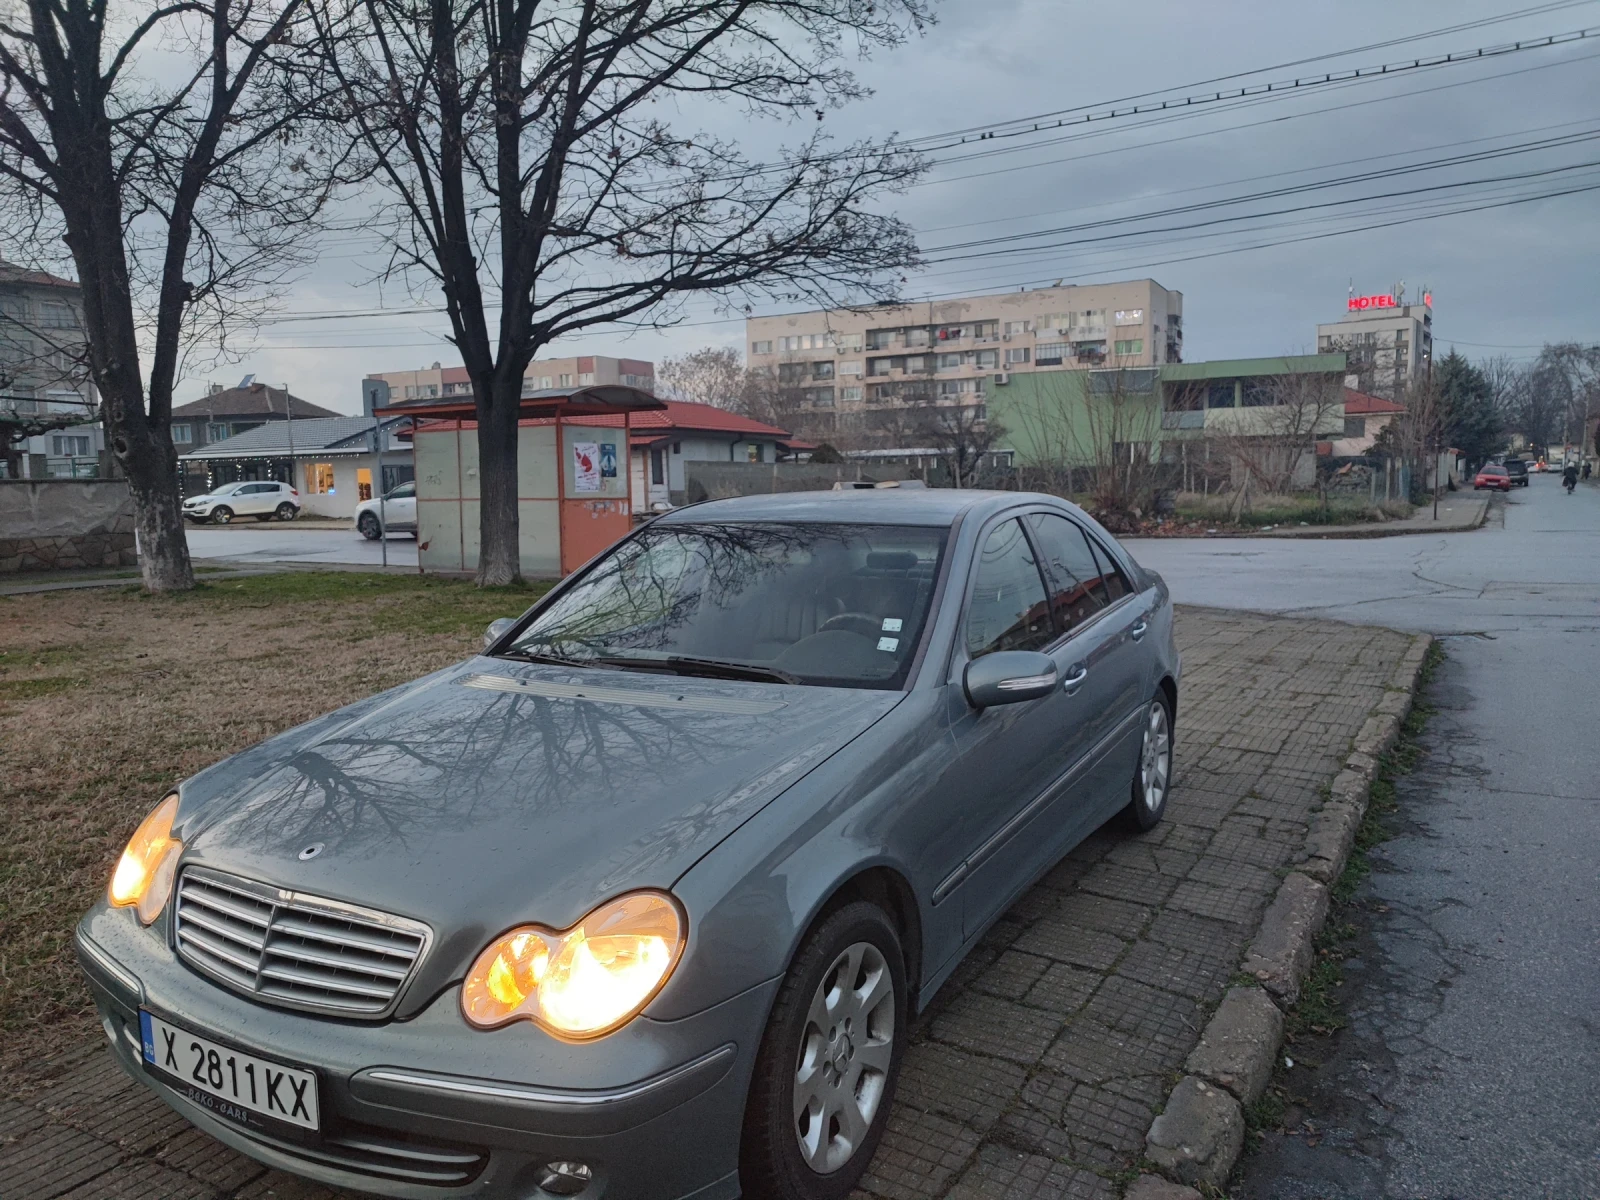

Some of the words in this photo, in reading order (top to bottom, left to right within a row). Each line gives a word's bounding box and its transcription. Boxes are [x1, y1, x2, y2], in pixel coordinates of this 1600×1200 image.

[1348, 295, 1396, 310] HOTEL
[144, 1041, 154, 1056] BG
[162, 1027, 179, 1072] X
